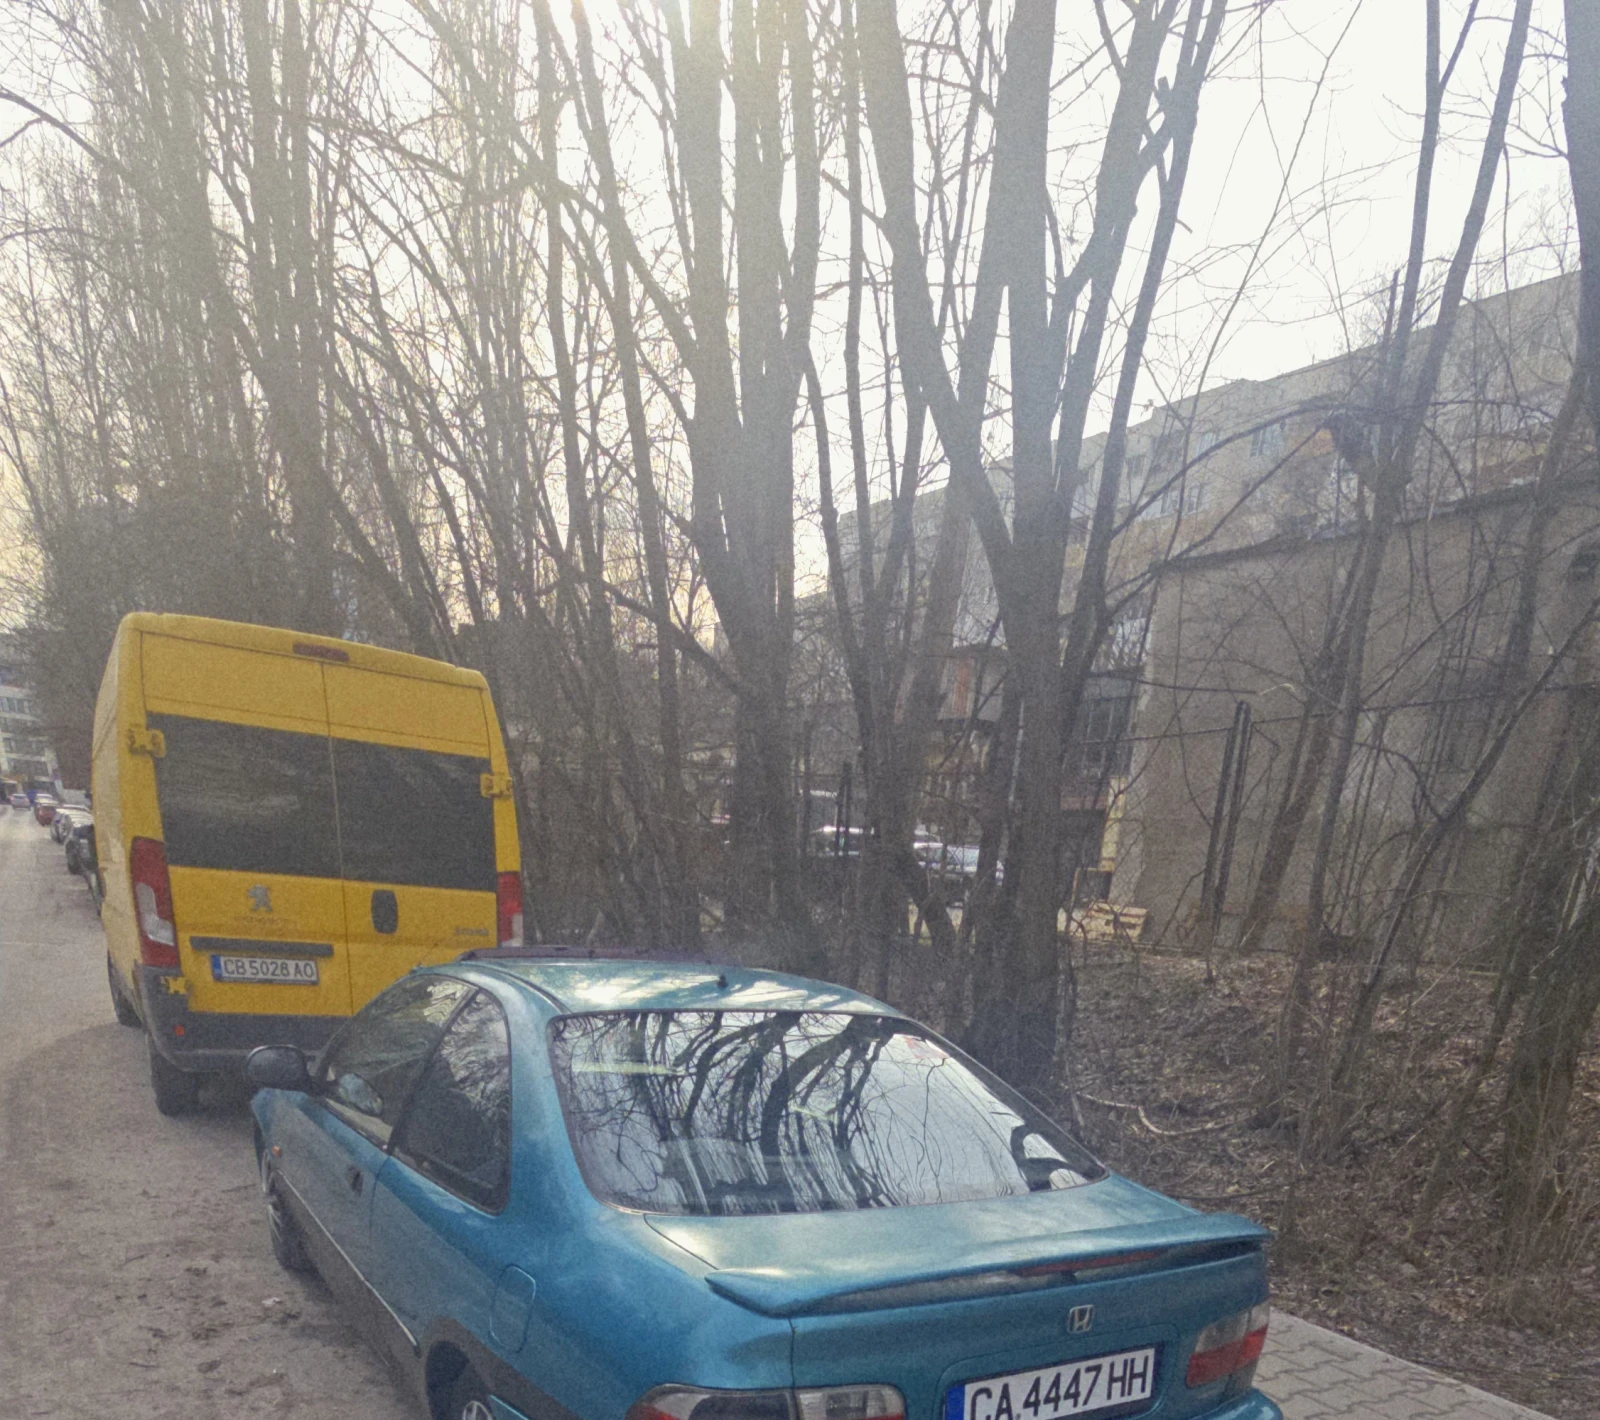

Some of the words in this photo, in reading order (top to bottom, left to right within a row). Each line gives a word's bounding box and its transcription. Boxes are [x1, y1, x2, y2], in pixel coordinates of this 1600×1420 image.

[223, 959, 247, 976] CB
[249, 960, 291, 977] 5028
[1022, 1363, 1103, 1417] 4447
[1106, 1355, 1149, 1400] HH
